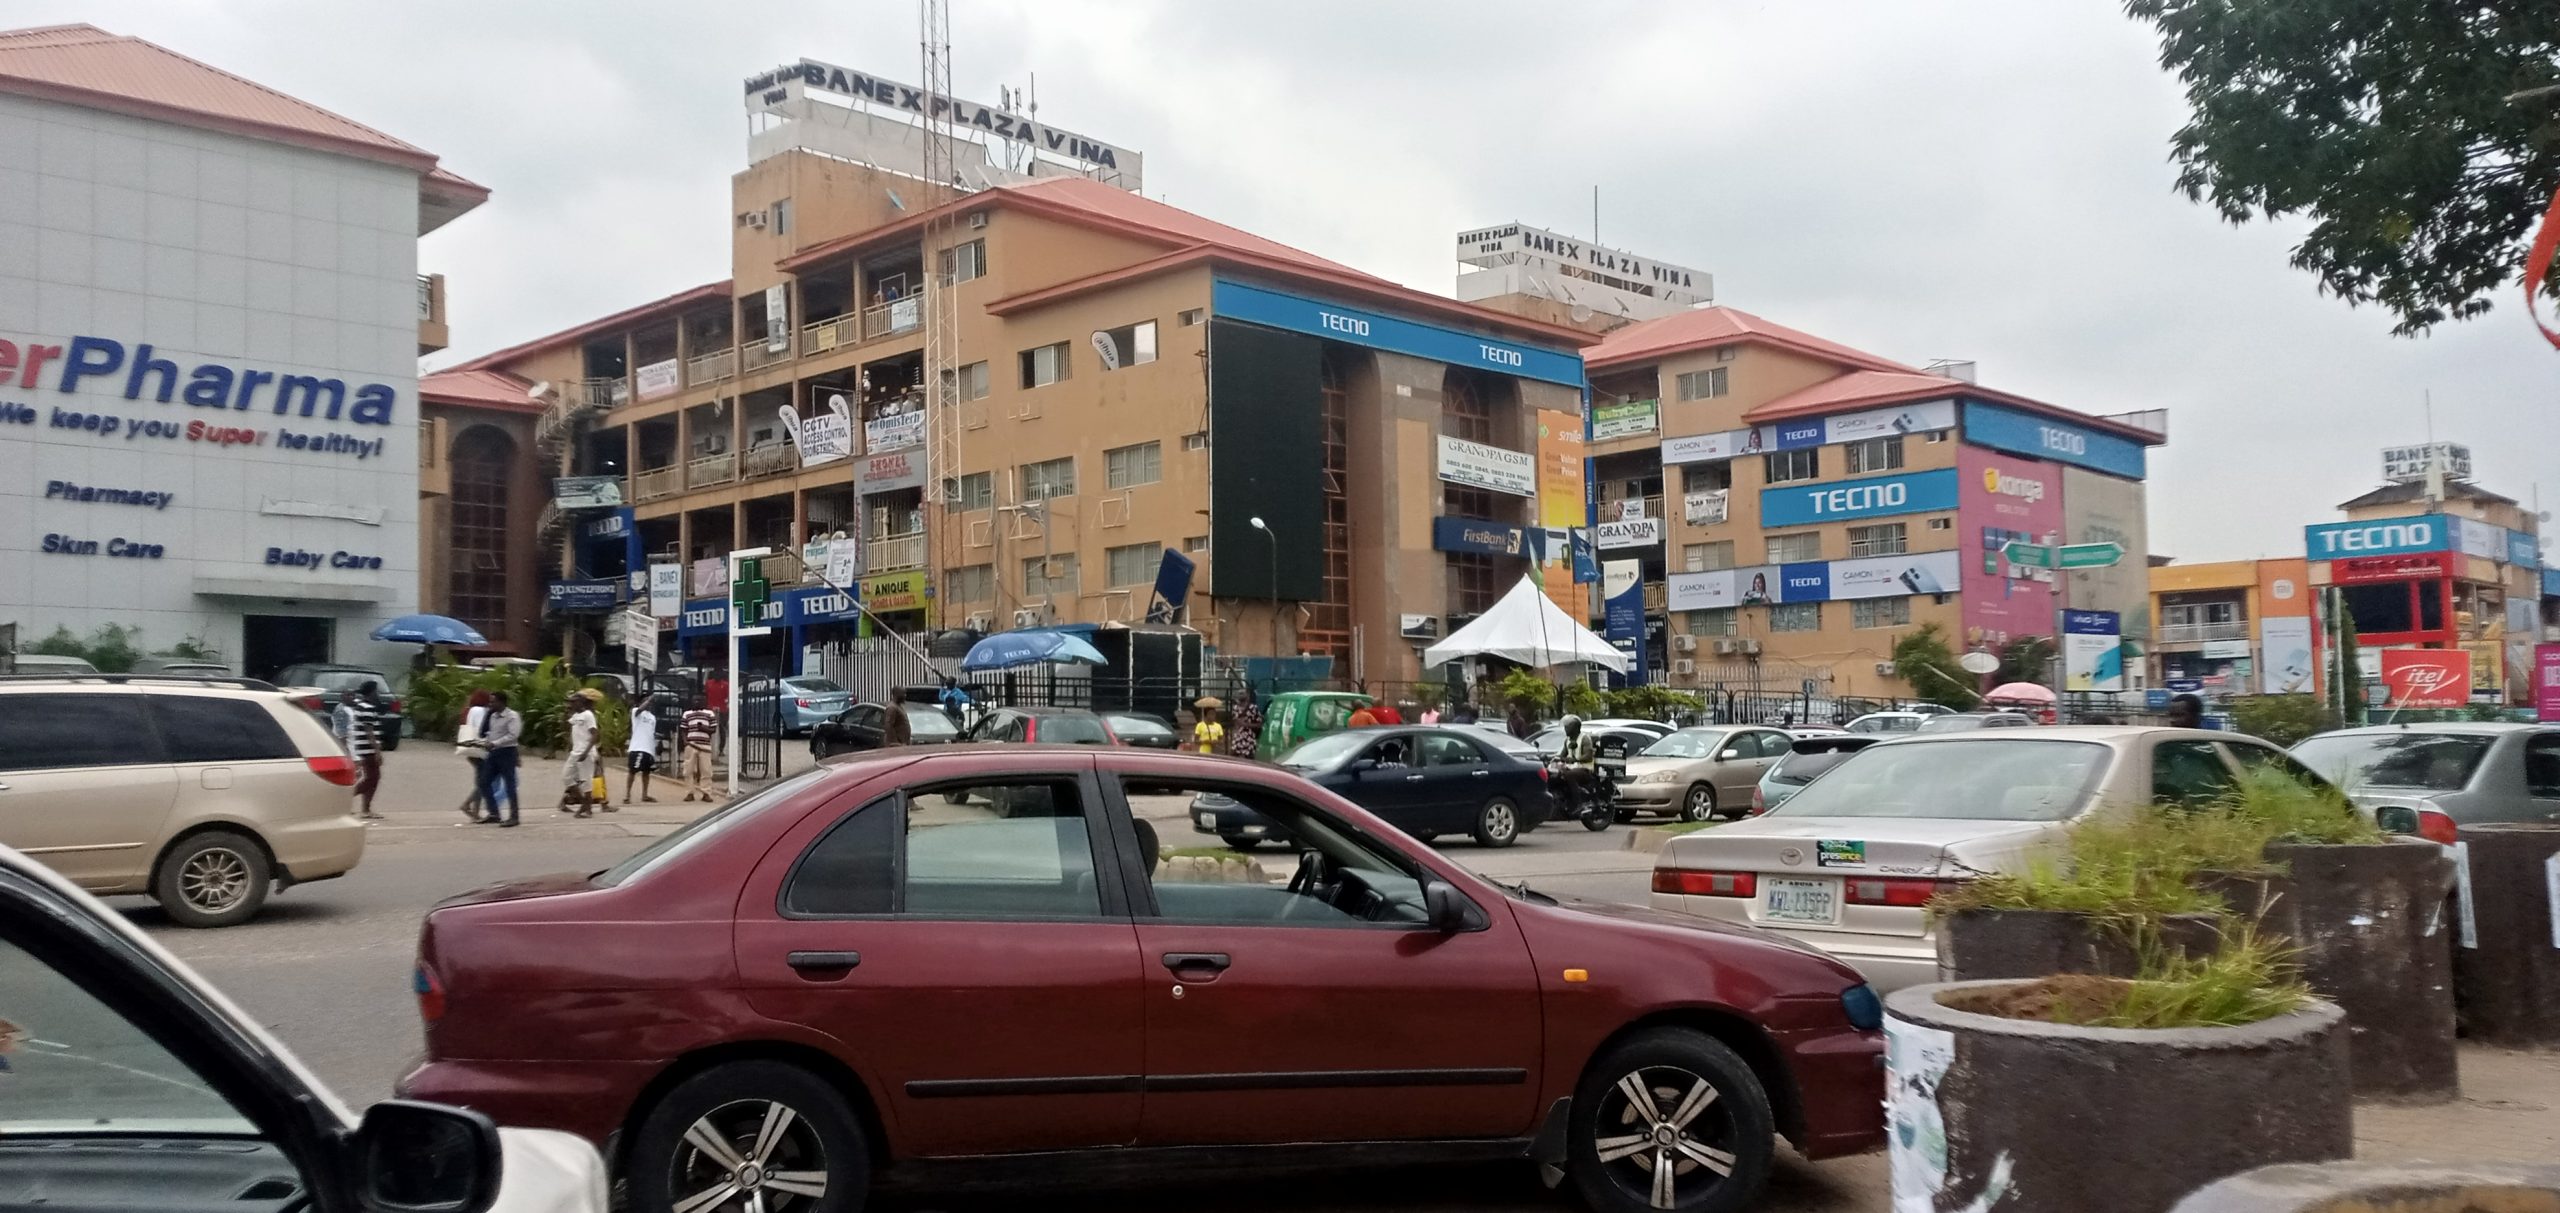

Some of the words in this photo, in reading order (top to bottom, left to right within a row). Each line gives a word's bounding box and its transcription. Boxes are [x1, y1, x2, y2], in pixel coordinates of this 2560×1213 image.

[803, 64, 922, 112] BANEX
[931, 97, 1035, 143] PLAZA
[1044, 129, 1117, 170] VINA
[1459, 228, 1490, 245] BANEX
[1493, 226, 1519, 240] PLAZA
[1480, 241, 1503, 253] VINA
[1524, 232, 1579, 260] BANEX
[1590, 250, 1641, 275] PLAZA
[1653, 265, 1691, 287] VINA
[1319, 312, 1369, 337] TECNO
[1479, 345, 1522, 367] TECNO
[51, 406, 120, 437] keep
[126, 418, 180, 441] you
[186, 420, 268, 447] Super
[277, 428, 384, 460] healthy!
[803, 417, 831, 433] CCTV
[1836, 418, 1867, 429] CAMON
[803, 433, 824, 446] ACCESS
[1558, 429, 1582, 444] smile
[1785, 428, 1818, 441] TECNO
[2039, 427, 2086, 455] TECNO
[1448, 441, 1502, 462] GRANDPA
[1504, 454, 1528, 466] GSM
[1673, 442, 1701, 451] CAMON
[45, 480, 174, 511] Pharmacy
[1808, 482, 1907, 514] TECNO
[1464, 528, 1508, 546] FirstBank
[1598, 522, 1656, 538] GRANDPA
[2318, 523, 2432, 552] TECNO
[42, 533, 98, 555] Skin
[107, 537, 164, 558] Care
[266, 547, 325, 572] Baby
[331, 550, 383, 569] Care
[1790, 577, 1821, 588] TECNO
[1842, 569, 1873, 580] CAMON
[875, 581, 910, 596] ANIQUE
[1679, 583, 1706, 592] CAMON
[801, 594, 849, 615] TECNO
[685, 608, 725, 627] TECNO
[2406, 669, 2447, 683] itel
